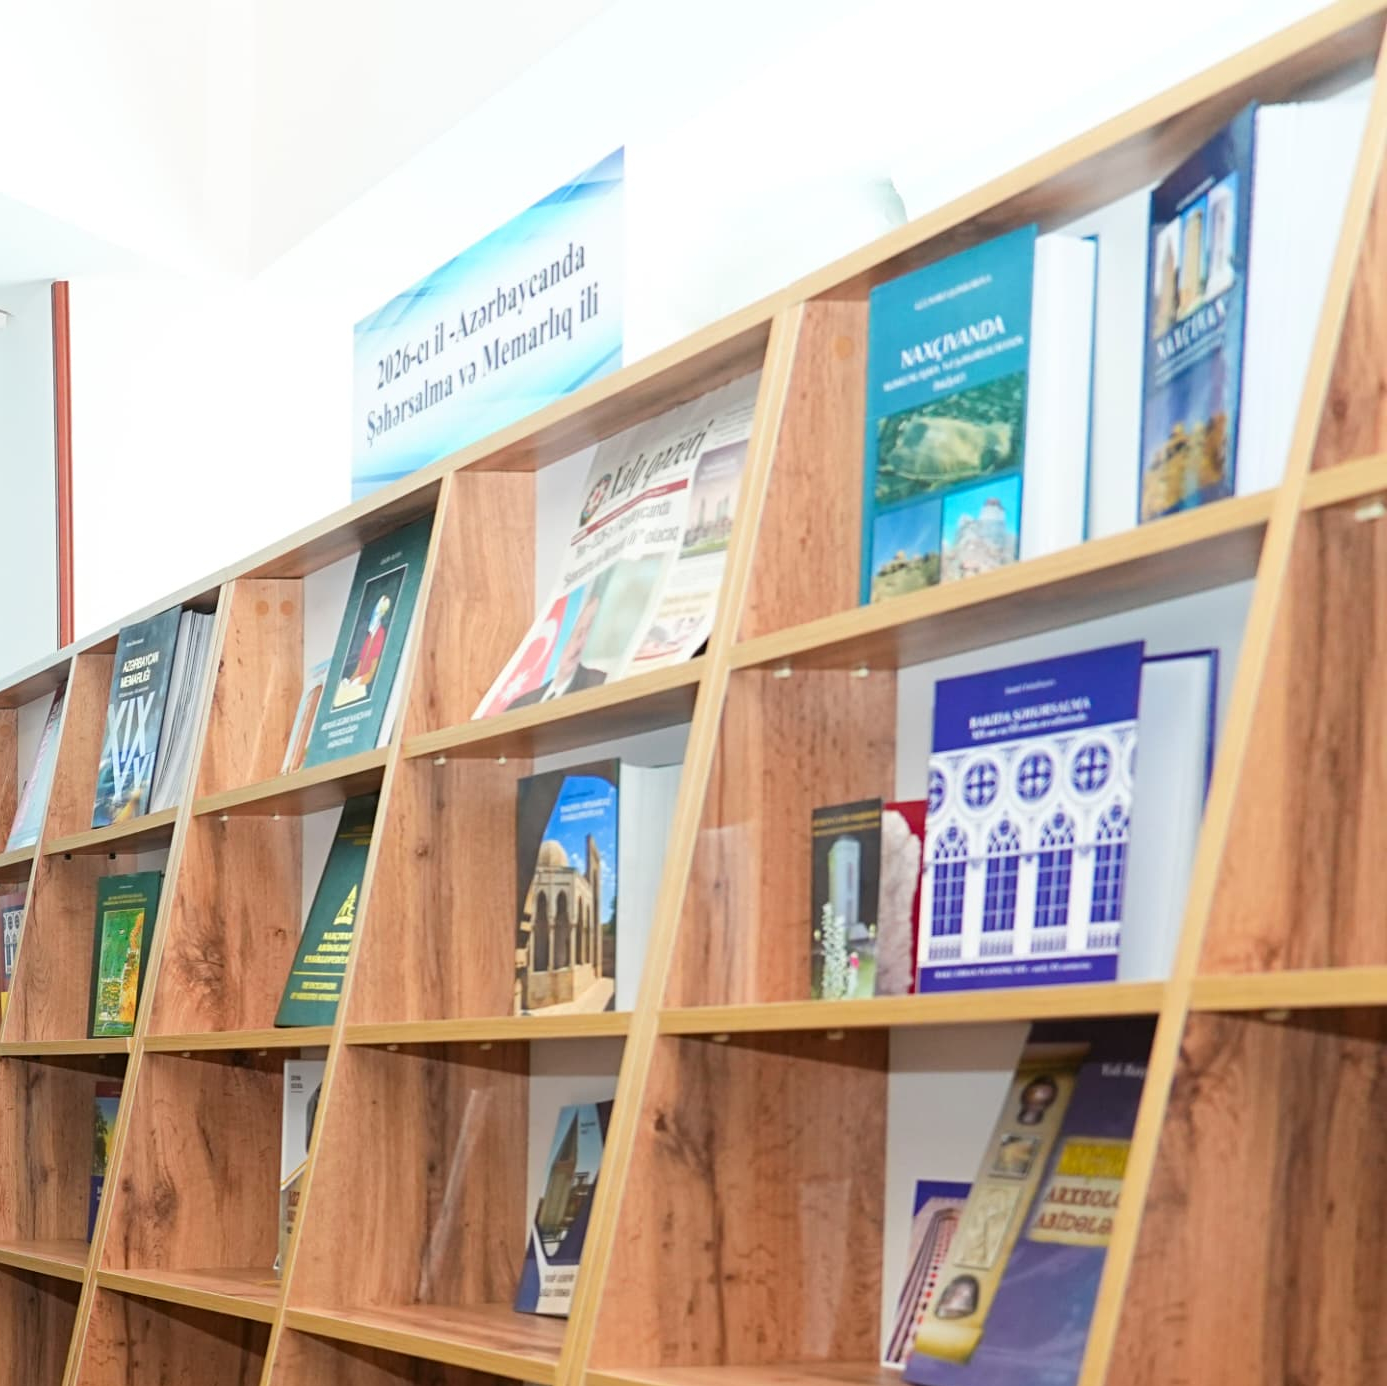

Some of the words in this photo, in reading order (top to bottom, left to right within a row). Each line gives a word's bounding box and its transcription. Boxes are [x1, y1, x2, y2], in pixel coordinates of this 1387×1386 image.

[366, 378, 453, 448] Şəhərsalma
[459, 362, 476, 389] və
[483, 305, 573, 378] Memarlıq
[580, 282, 599, 324] ili
[377, 342, 430, 390] 2026-cı
[434, 322, 445, 357] il
[900, 314, 1006, 370] NAXÇIVANDA
[123, 650, 159, 673] AZƏRBAYCAN
